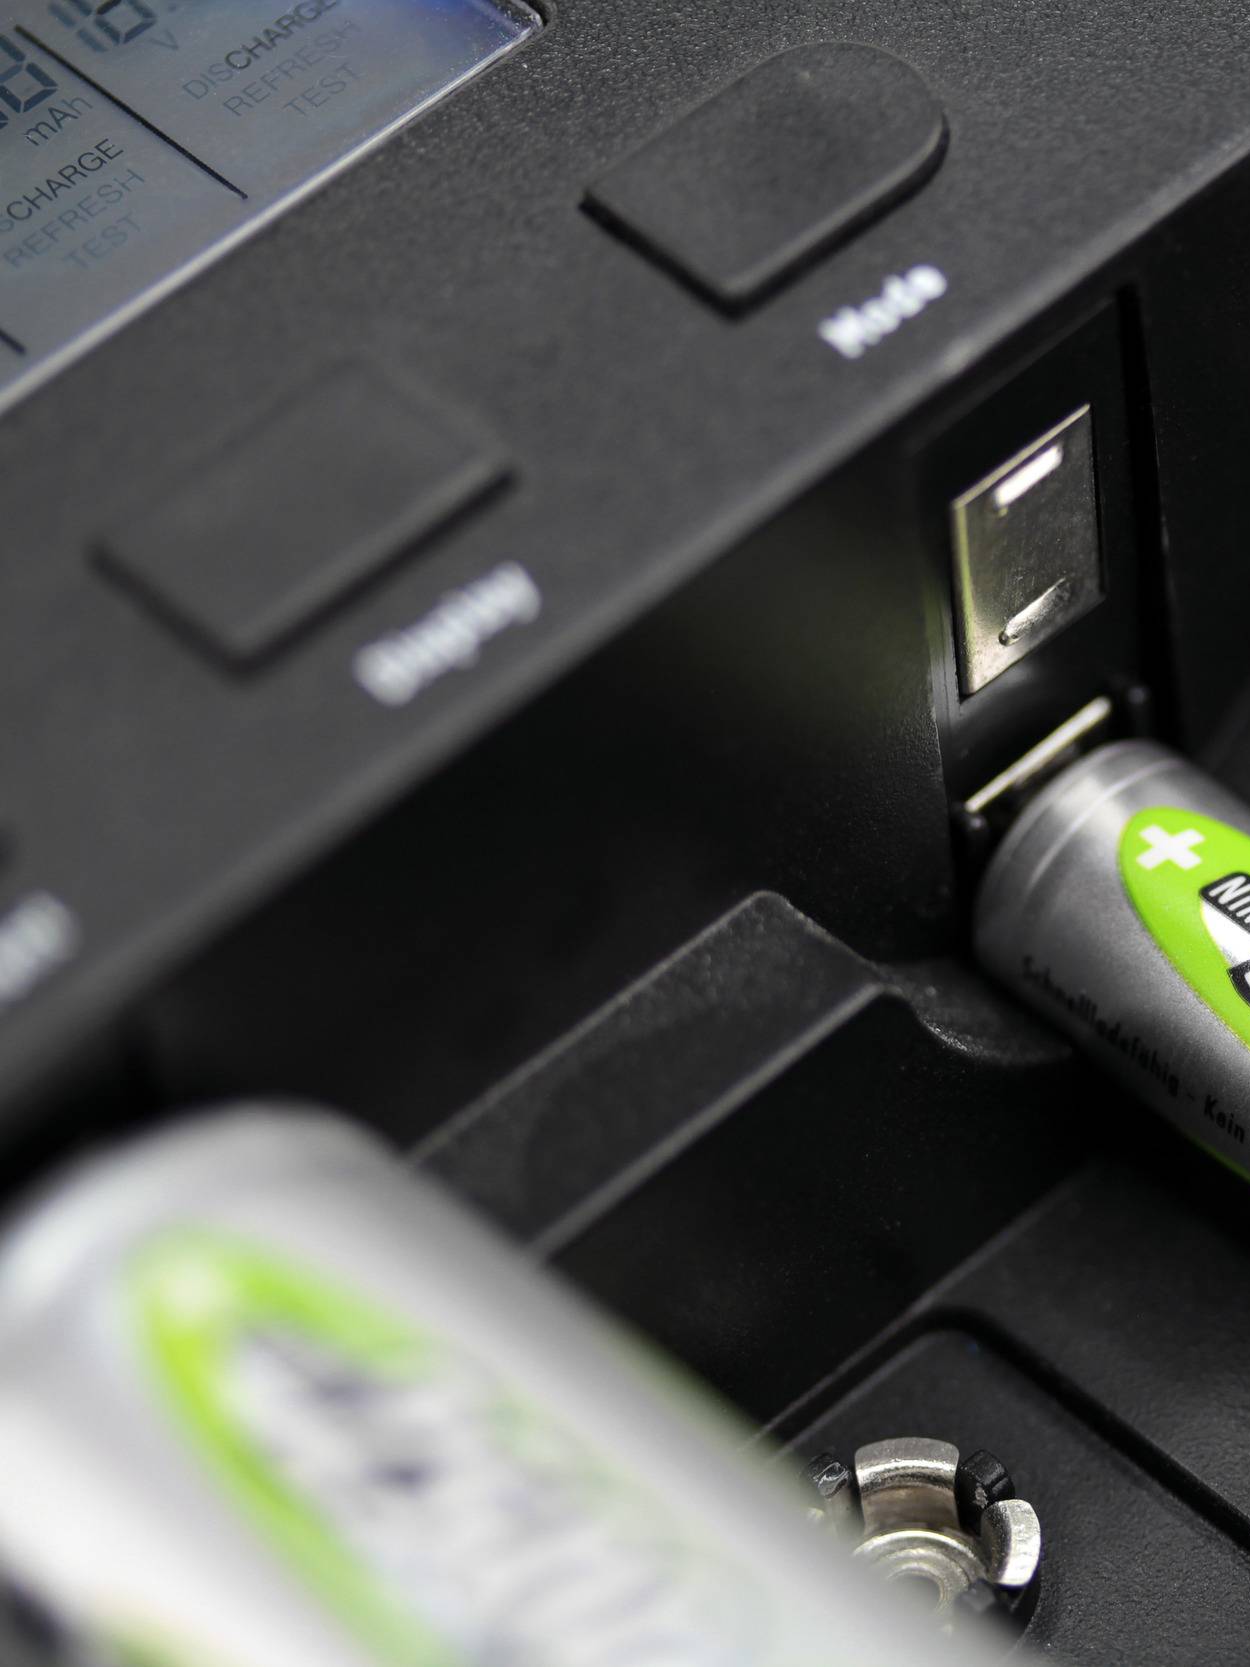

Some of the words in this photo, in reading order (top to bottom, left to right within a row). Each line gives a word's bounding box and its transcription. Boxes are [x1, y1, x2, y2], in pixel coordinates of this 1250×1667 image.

[222, 19, 361, 116] REFRESH
[283, 60, 361, 117] TEST
[25, 96, 93, 146] mAh
[3, 168, 145, 269] REFRESH
[62, 211, 141, 270] TEST
[1203, 1094, 1246, 1144] Kein
